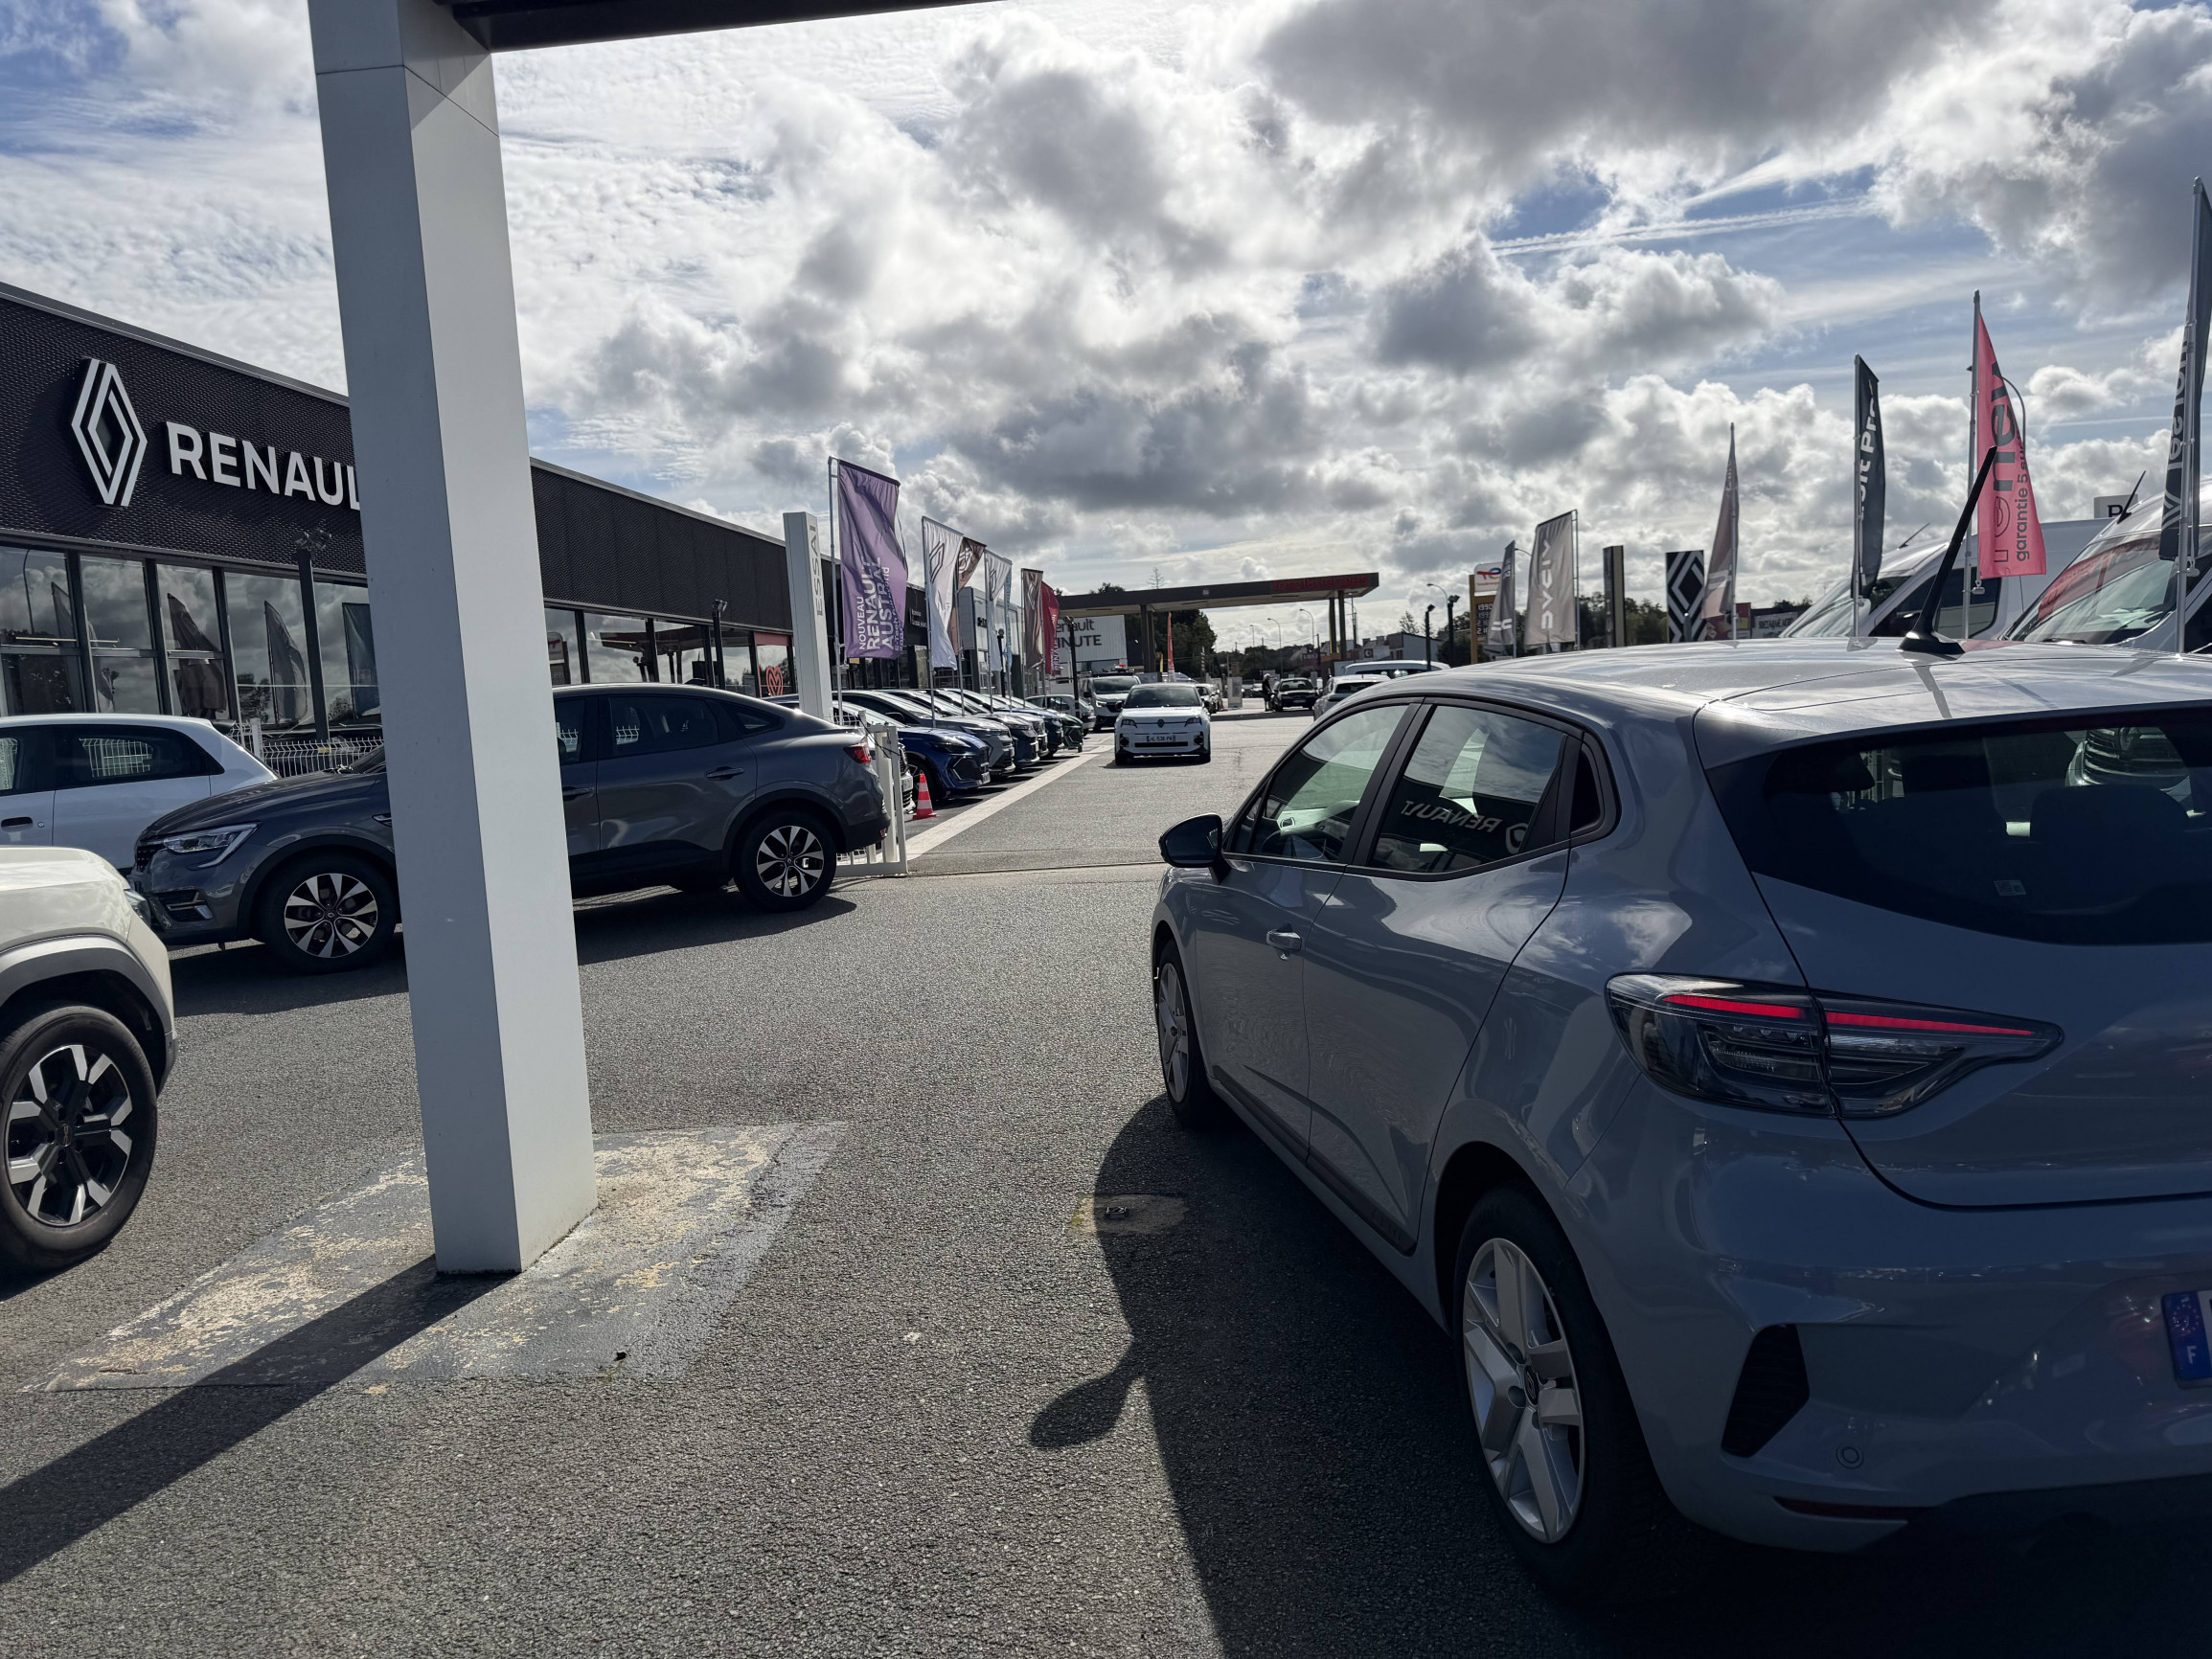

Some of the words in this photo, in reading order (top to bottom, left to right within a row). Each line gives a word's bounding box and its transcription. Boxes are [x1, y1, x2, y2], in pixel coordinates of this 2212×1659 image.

[166, 420, 361, 511] RENAUL
[2018, 474, 2028, 484] 5
[2016, 488, 2029, 562] garantie
[810, 524, 823, 617] ESSAI
[861, 557, 881, 650] RENAULT
[873, 557, 894, 650] AUSTRAL
[856, 596, 865, 650] NOUVEAU
[1058, 634, 1102, 648] INUTE
[2186, 1345, 2197, 1364] F
